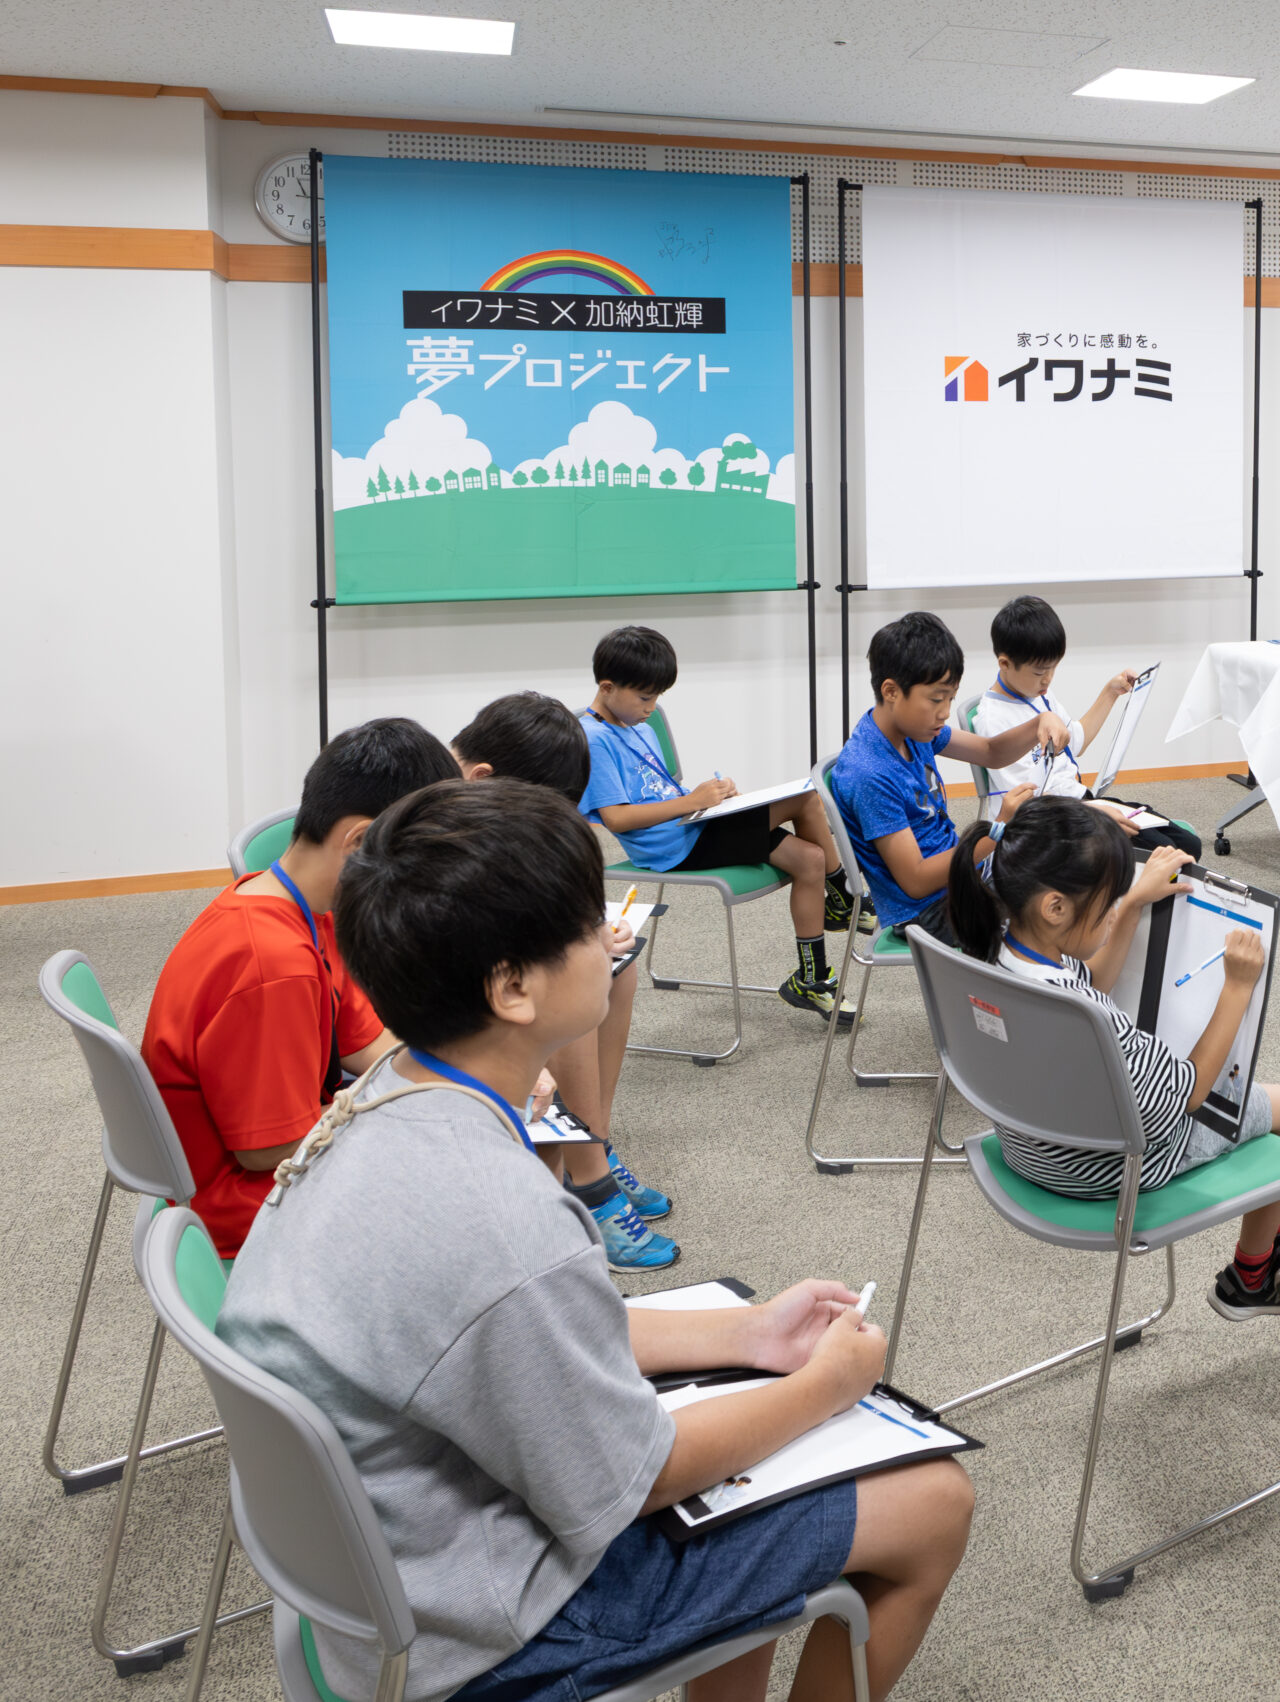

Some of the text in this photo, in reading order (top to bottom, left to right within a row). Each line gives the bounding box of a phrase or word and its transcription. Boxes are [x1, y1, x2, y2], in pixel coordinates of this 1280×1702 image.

[286, 167, 295, 178] 11
[274, 176, 286, 188] 10
[271, 189, 280, 201] 9
[276, 204, 285, 215] 8
[287, 215, 295, 226] 7
[302, 219, 311, 230] 6
[1017, 332, 1158, 349] 家づくりに感動を。
[406, 336, 730, 399] 夢プロジェクト
[998, 357, 1173, 402] イワナミ
